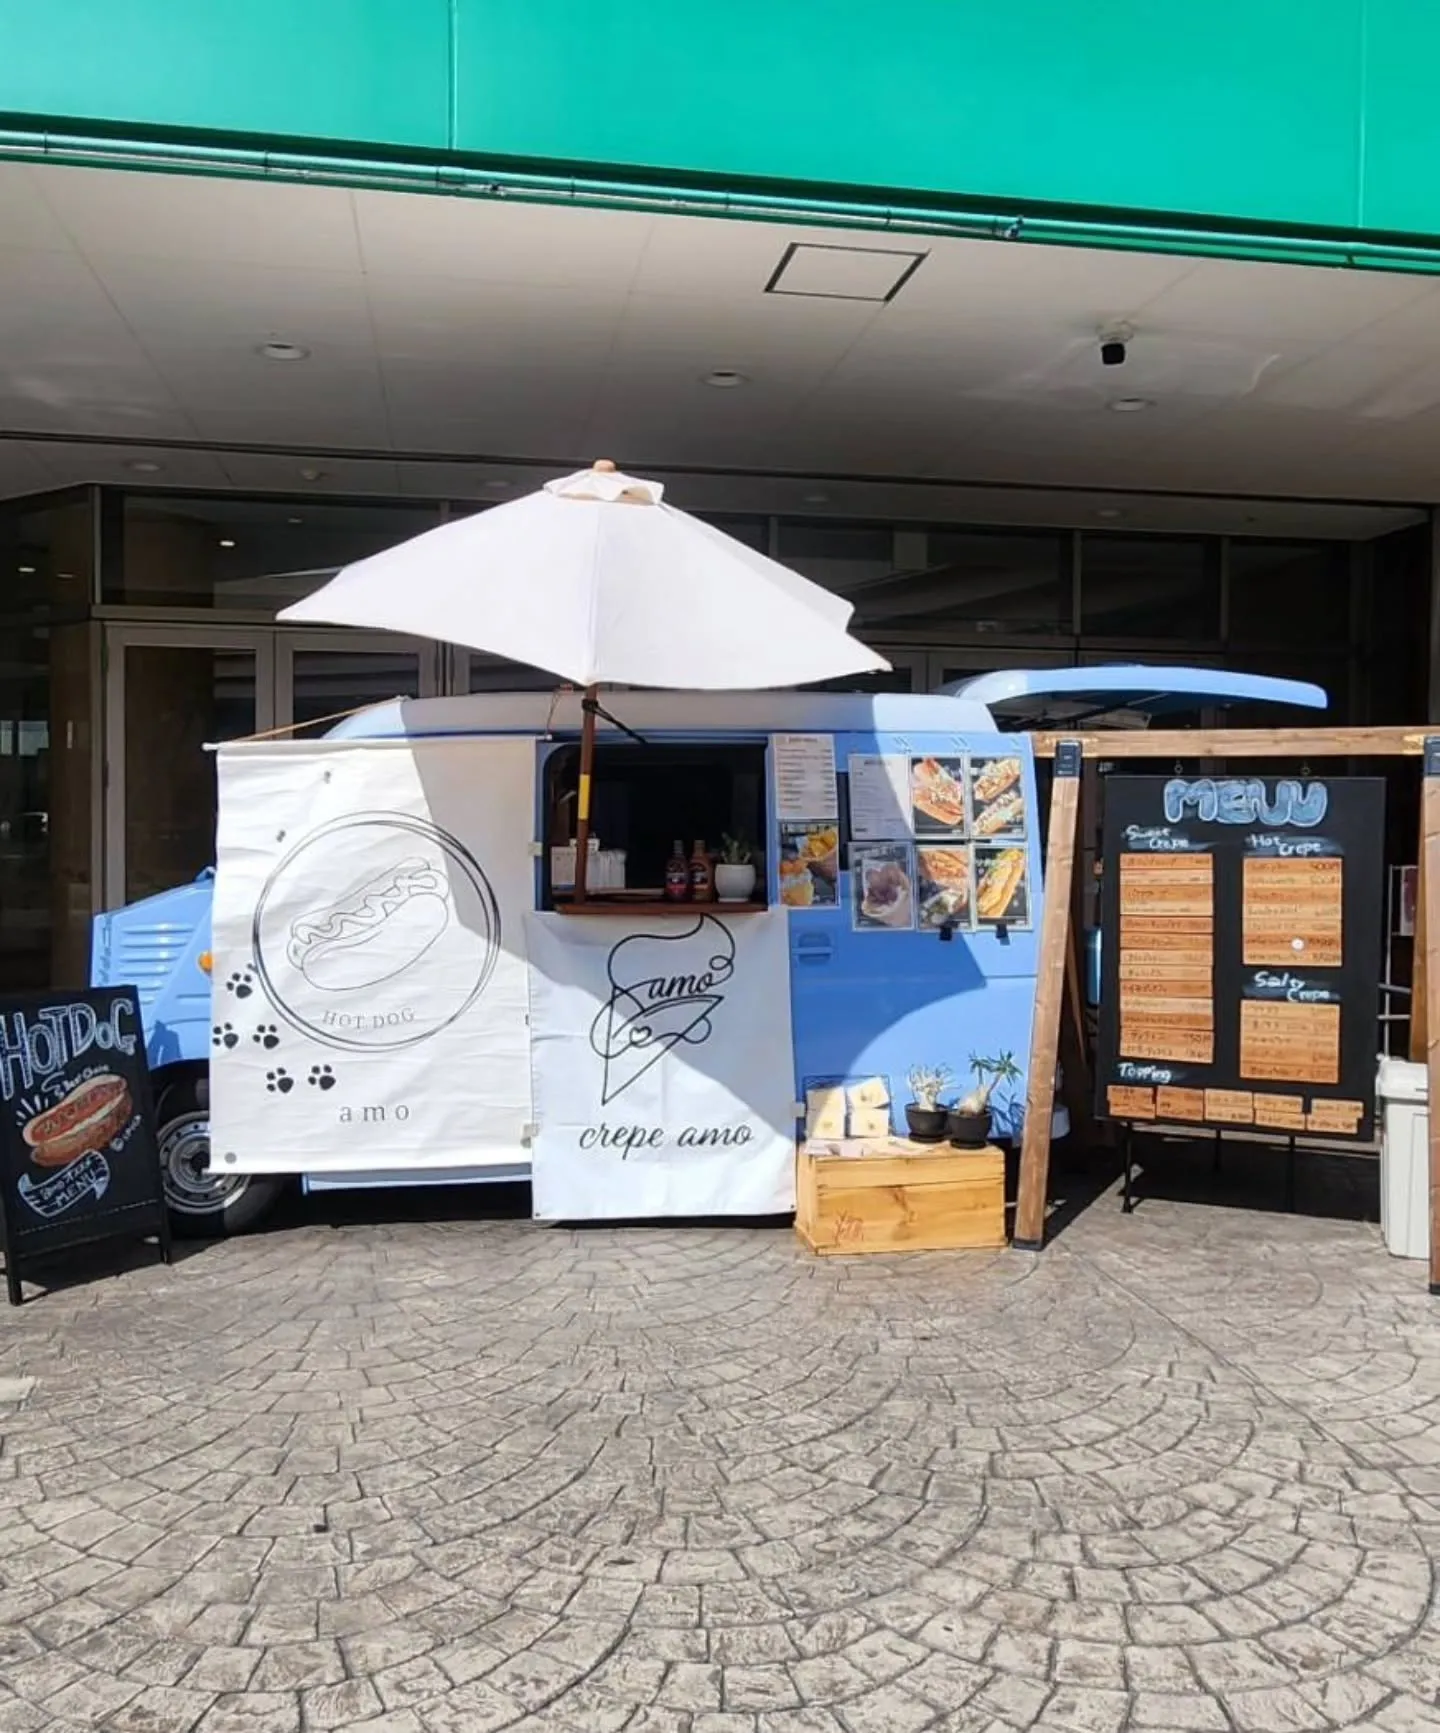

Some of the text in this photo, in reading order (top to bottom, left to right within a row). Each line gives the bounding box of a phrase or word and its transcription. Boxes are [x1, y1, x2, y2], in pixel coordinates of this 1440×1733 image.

[1164, 778, 1328, 827] MENU
[649, 970, 716, 1000] amo
[321, 1007, 415, 1029] HOT DOG
[579, 1122, 754, 1161] crepe amo
